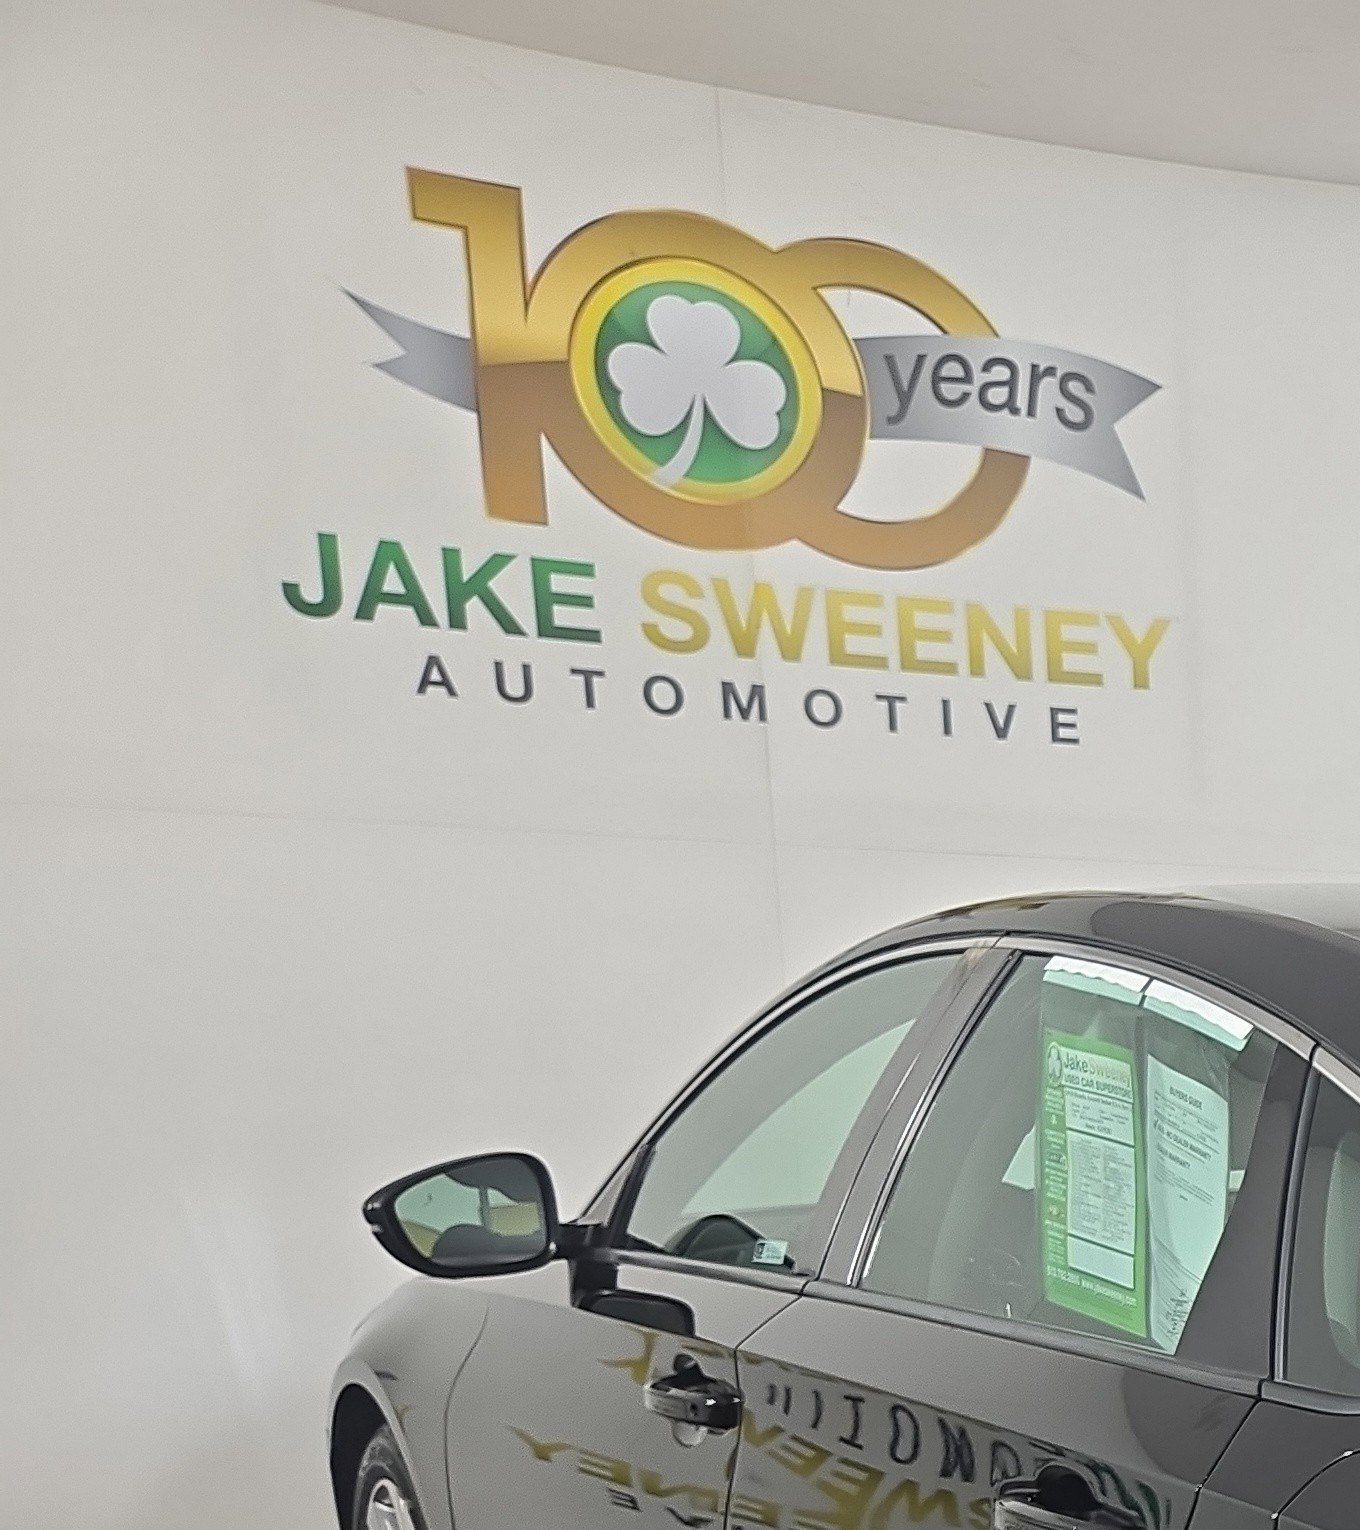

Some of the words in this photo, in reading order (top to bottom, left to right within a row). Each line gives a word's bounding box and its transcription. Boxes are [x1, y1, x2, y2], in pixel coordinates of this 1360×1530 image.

[883, 348, 1098, 433] years
[281, 531, 602, 645] JAKE
[638, 568, 1171, 691] SWEENEY
[415, 653, 1082, 745] AUTOMOTIVE
